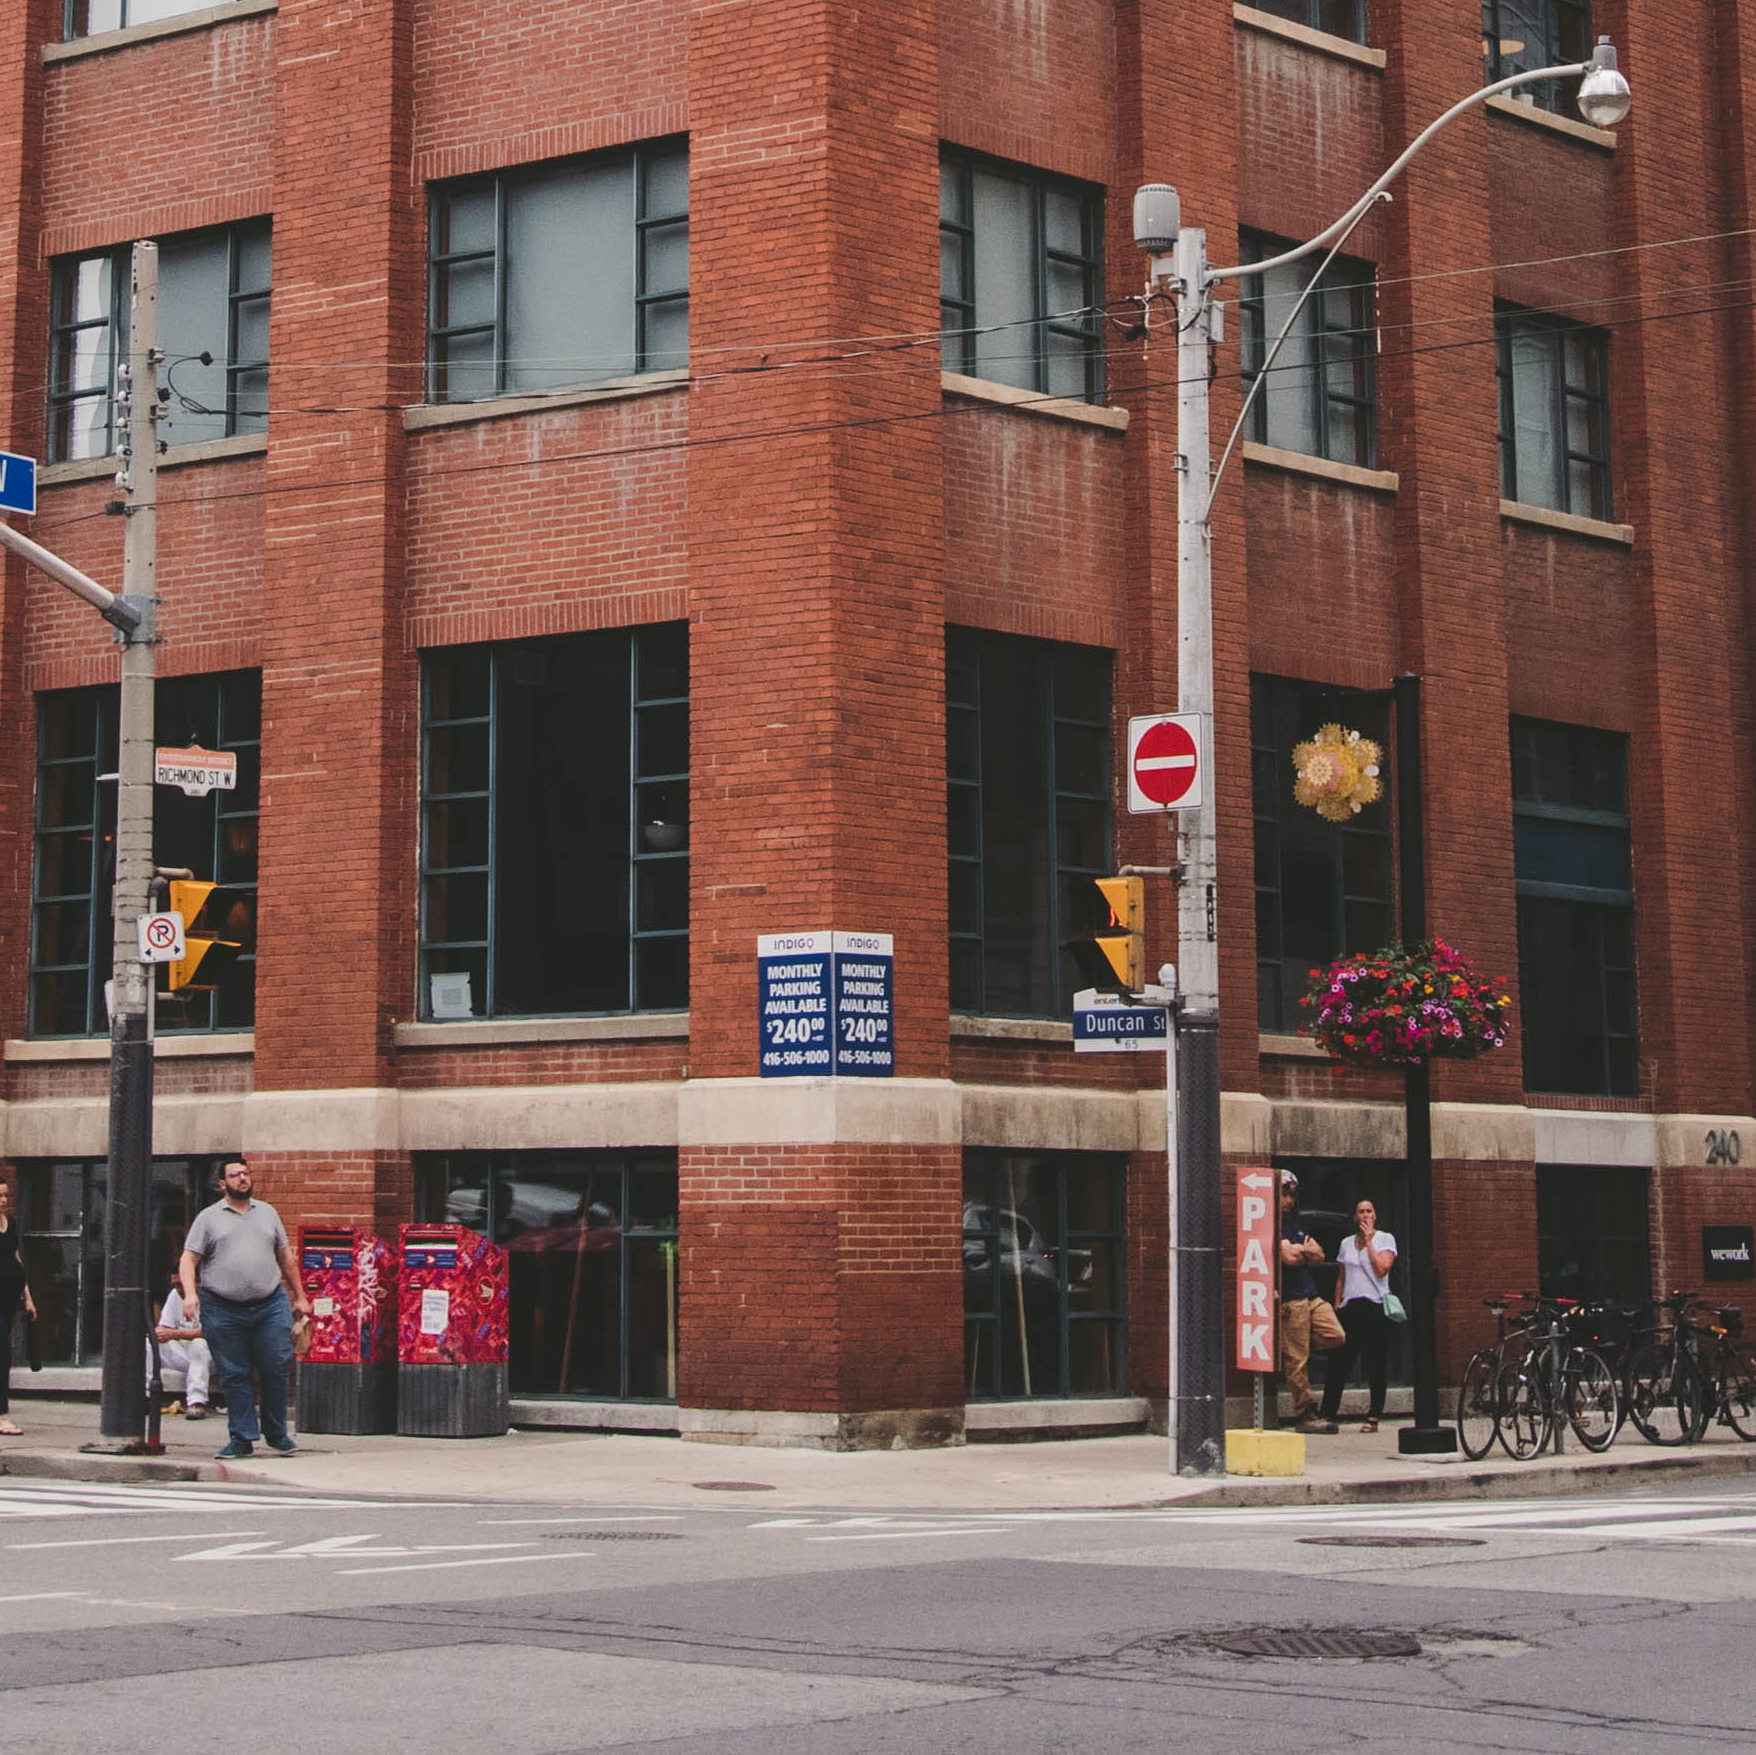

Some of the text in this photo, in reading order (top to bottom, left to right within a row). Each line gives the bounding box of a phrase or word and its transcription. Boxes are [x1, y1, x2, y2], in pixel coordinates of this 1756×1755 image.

[158, 767, 232, 786] RICHMOND ST W
[767, 963, 823, 980] MONTHLY
[841, 963, 886, 979] MONTHLY
[769, 981, 821, 997] PARKING
[843, 981, 885, 996] PARKING
[765, 998, 827, 1014] AVAILABLE
[839, 998, 889, 1013] AVAILABLE
[1086, 1014, 1165, 1032] Duncan St
[763, 1050, 829, 1066] 416-506-1000
[838, 1050, 892, 1065] 416-506-1000
[1705, 1129, 1740, 1165] 240
[1710, 1242, 1750, 1260] wework
[1240, 1195, 1270, 1360] PARK
